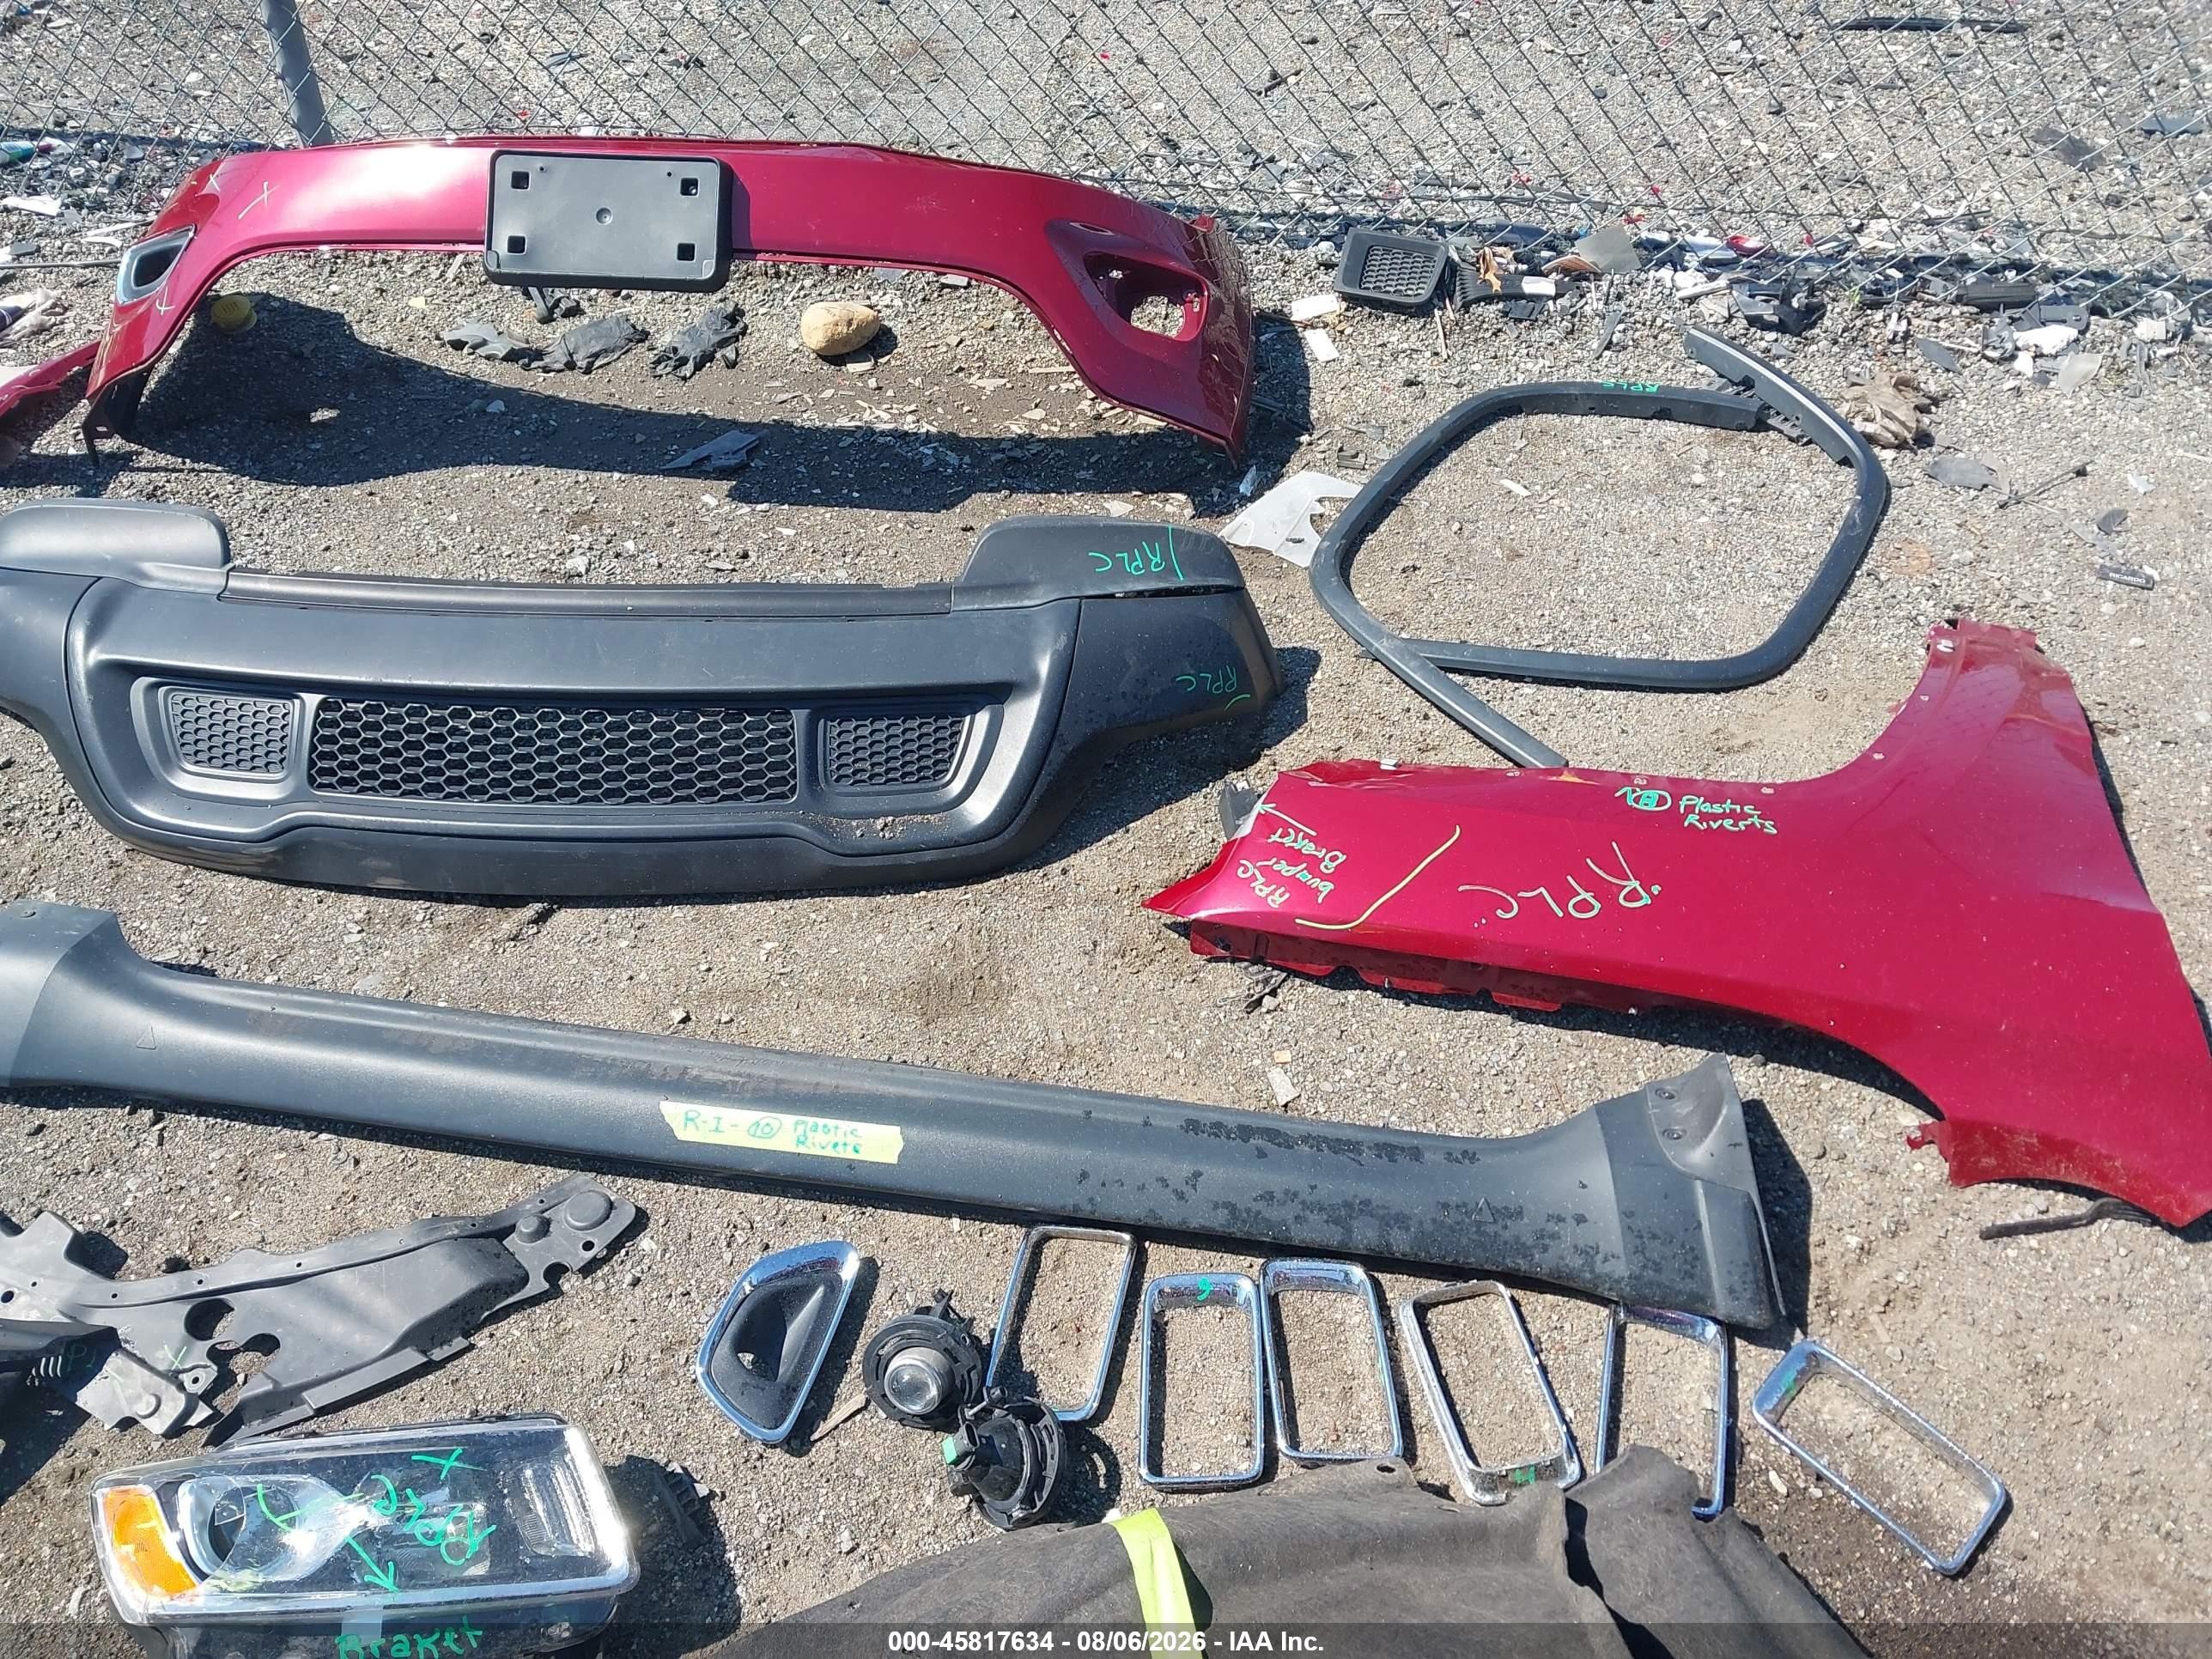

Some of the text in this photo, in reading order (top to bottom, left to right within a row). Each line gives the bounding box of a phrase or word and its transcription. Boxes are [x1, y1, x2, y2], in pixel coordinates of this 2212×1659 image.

[1088, 541, 1165, 575] RPLC
[2108, 572, 2146, 584] RICARDO
[1175, 664, 1237, 694] RPLC
[1680, 795, 1761, 814] Plastic
[1237, 859, 1291, 908] RPLC
[1458, 840, 1652, 920] RPLC
[793, 1119, 863, 1139] Plastic
[795, 1134, 862, 1155] Rivets
